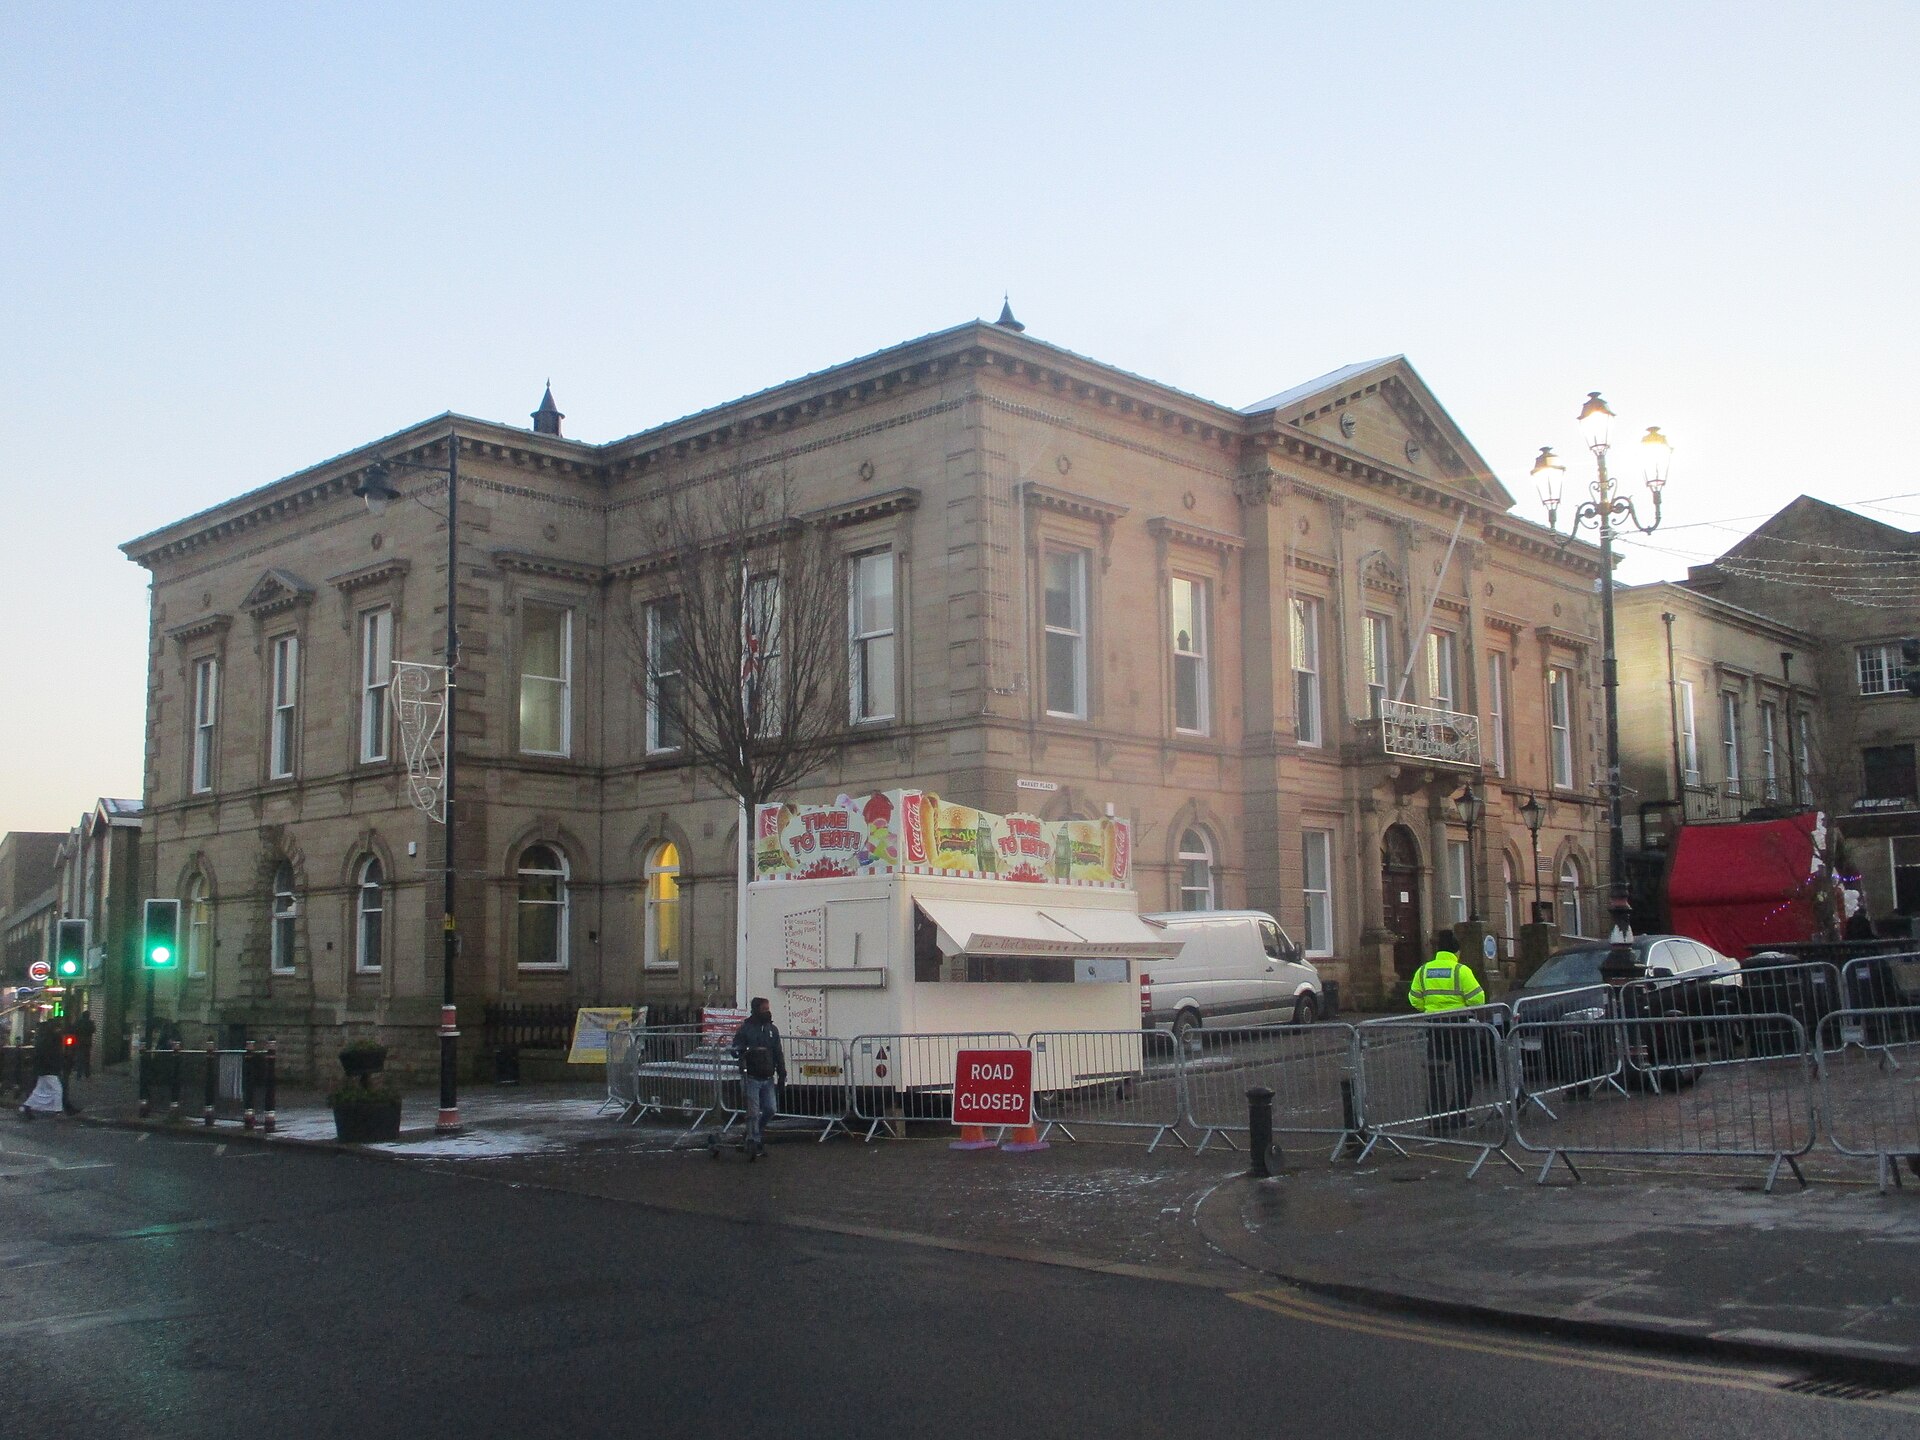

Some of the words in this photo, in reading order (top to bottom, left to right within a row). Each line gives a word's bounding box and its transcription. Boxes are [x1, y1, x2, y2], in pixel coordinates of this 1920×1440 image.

[1020, 780, 1039, 788] MARKET
[1039, 782, 1054, 790] PLACE
[801, 811, 848, 832] TIME
[908, 803, 925, 859] Coca-Cola
[1006, 818, 1041, 839] TIME
[789, 832, 815, 855] TO
[819, 830, 861, 851] EAT!
[998, 835, 1018, 856] TO
[791, 990, 817, 1004] Popcorn
[791, 1006, 814, 1019] Nougat
[971, 1063, 1014, 1081] ROAD
[960, 1093, 1024, 1111] CLOSED
